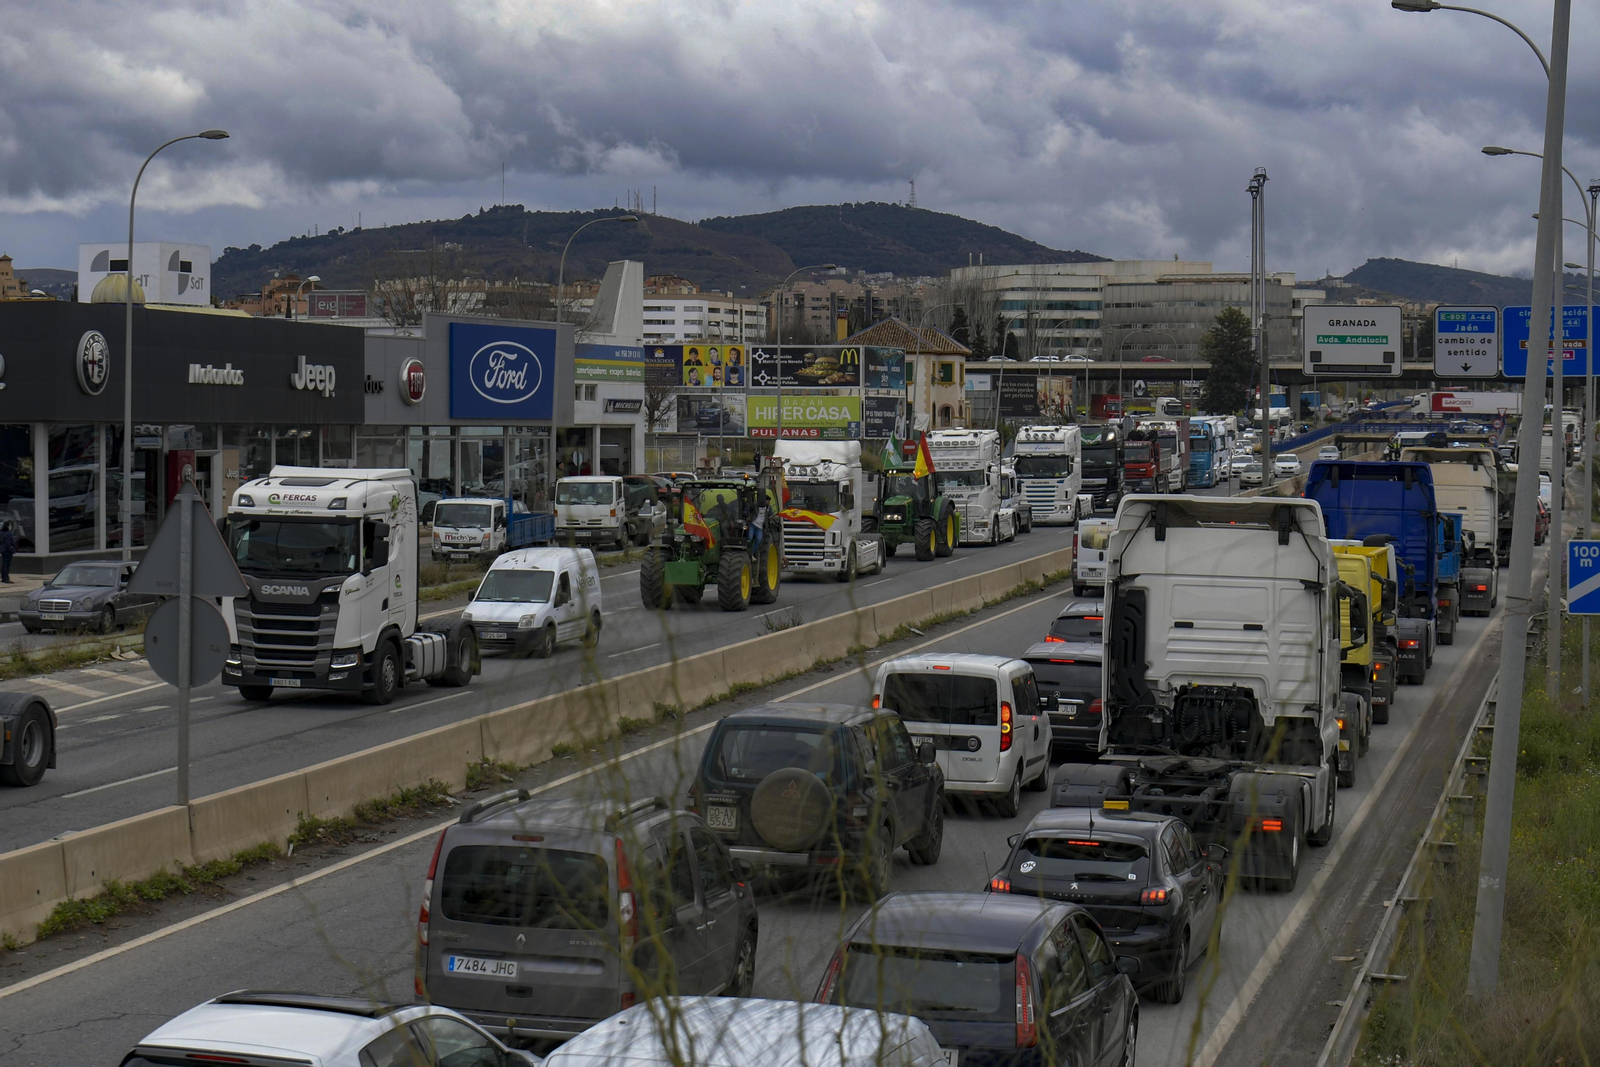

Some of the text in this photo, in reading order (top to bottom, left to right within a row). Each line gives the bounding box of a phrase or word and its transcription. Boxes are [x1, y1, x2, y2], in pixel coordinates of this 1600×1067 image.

[190, 276, 204, 291] SdT
[1328, 319, 1378, 328] GRANADA
[1455, 323, 1479, 332] Jaén
[485, 350, 528, 390] Ford
[291, 355, 336, 398] Jeep
[410, 372, 424, 393] FIAT
[227, 468, 239, 480] Jeep
[283, 493, 317, 502] FERCAS
[1573, 546, 1600, 558] 100
[1580, 558, 1593, 567] m
[261, 584, 310, 597] SCANIA
[1061, 705, 1076, 713] JLG
[710, 816, 733, 827] 5545
[1022, 861, 1036, 870] OK
[456, 958, 516, 977] 7484 JHC
